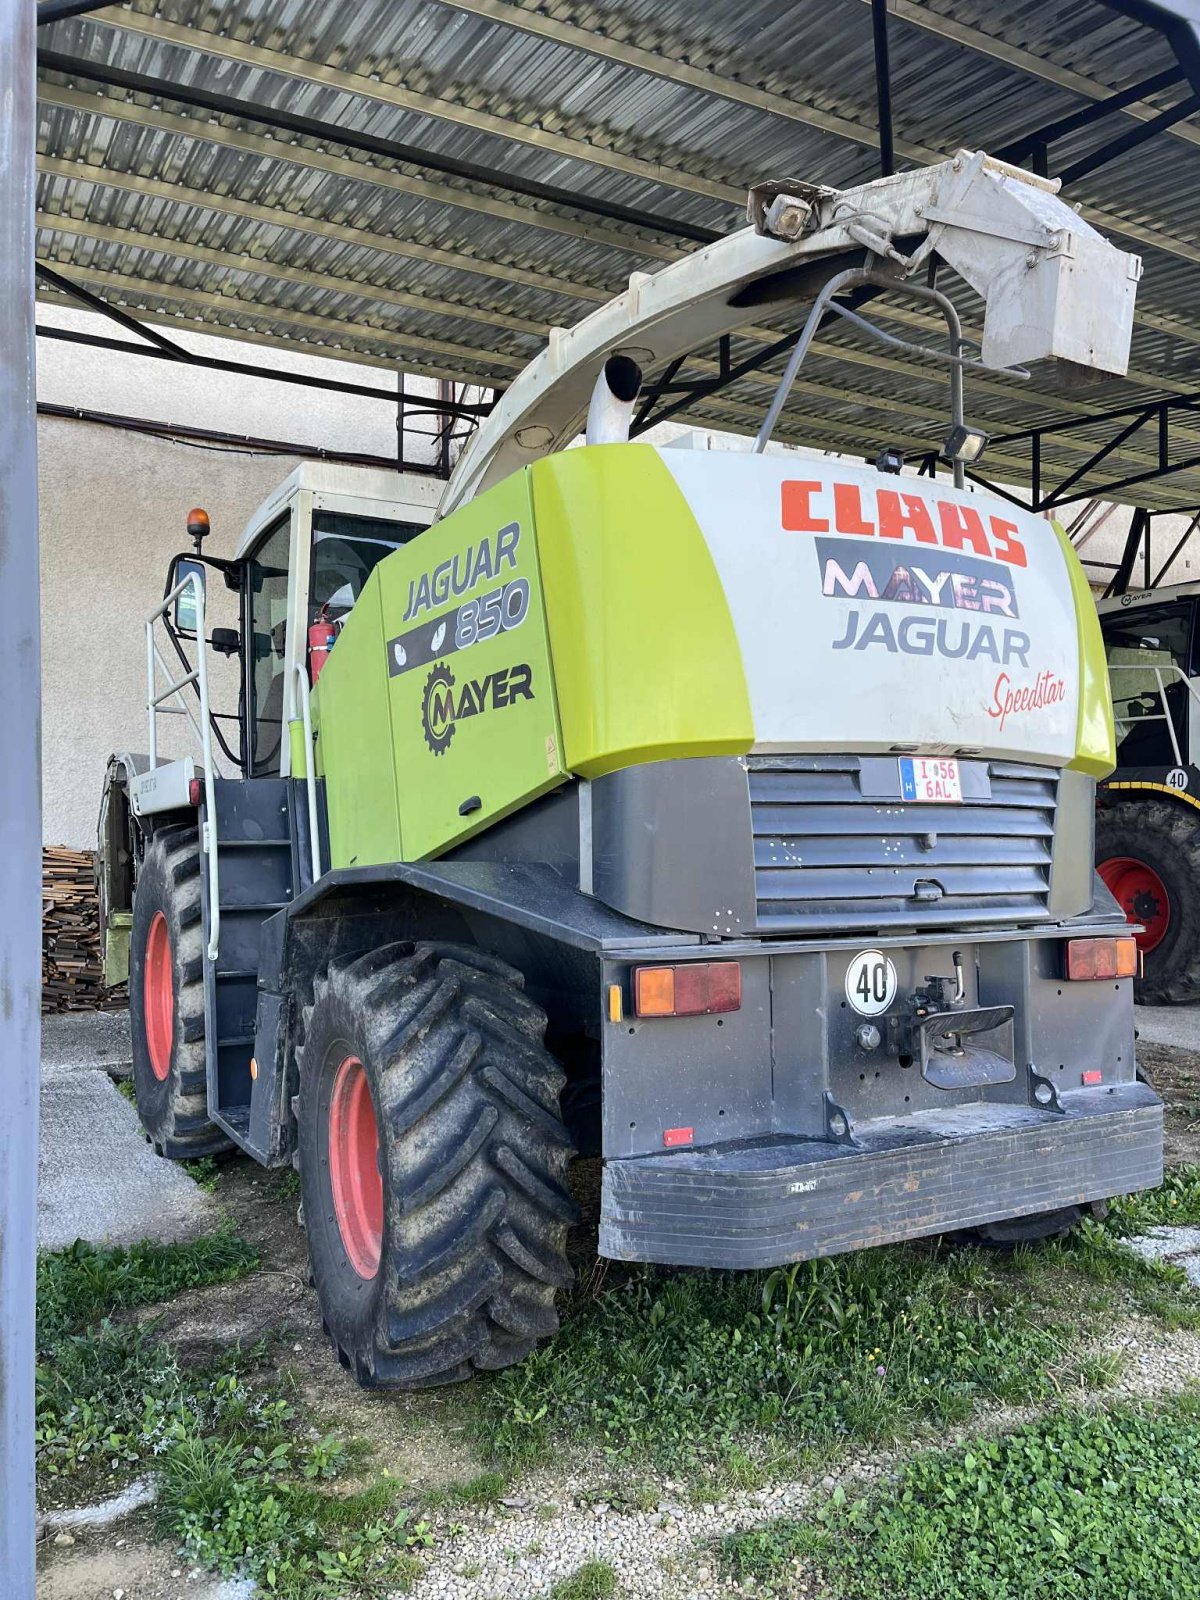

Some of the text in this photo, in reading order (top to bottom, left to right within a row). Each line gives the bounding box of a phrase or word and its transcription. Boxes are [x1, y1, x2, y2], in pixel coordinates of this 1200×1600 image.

[781, 480, 1027, 568] CLAAS
[402, 521, 521, 622] JAGUAR
[822, 558, 1018, 619] MAYER
[1123, 593, 1152, 604] MAYER
[455, 577, 530, 650] 850
[832, 610, 1031, 668] JAGUAR
[432, 663, 535, 727] MAYER
[988, 670, 1066, 731] Speedstar
[905, 782, 913, 792] H
[926, 781, 951, 798] 6AL
[940, 762, 955, 779] 56
[1169, 773, 1184, 788] 40
[856, 963, 887, 1003] 40
